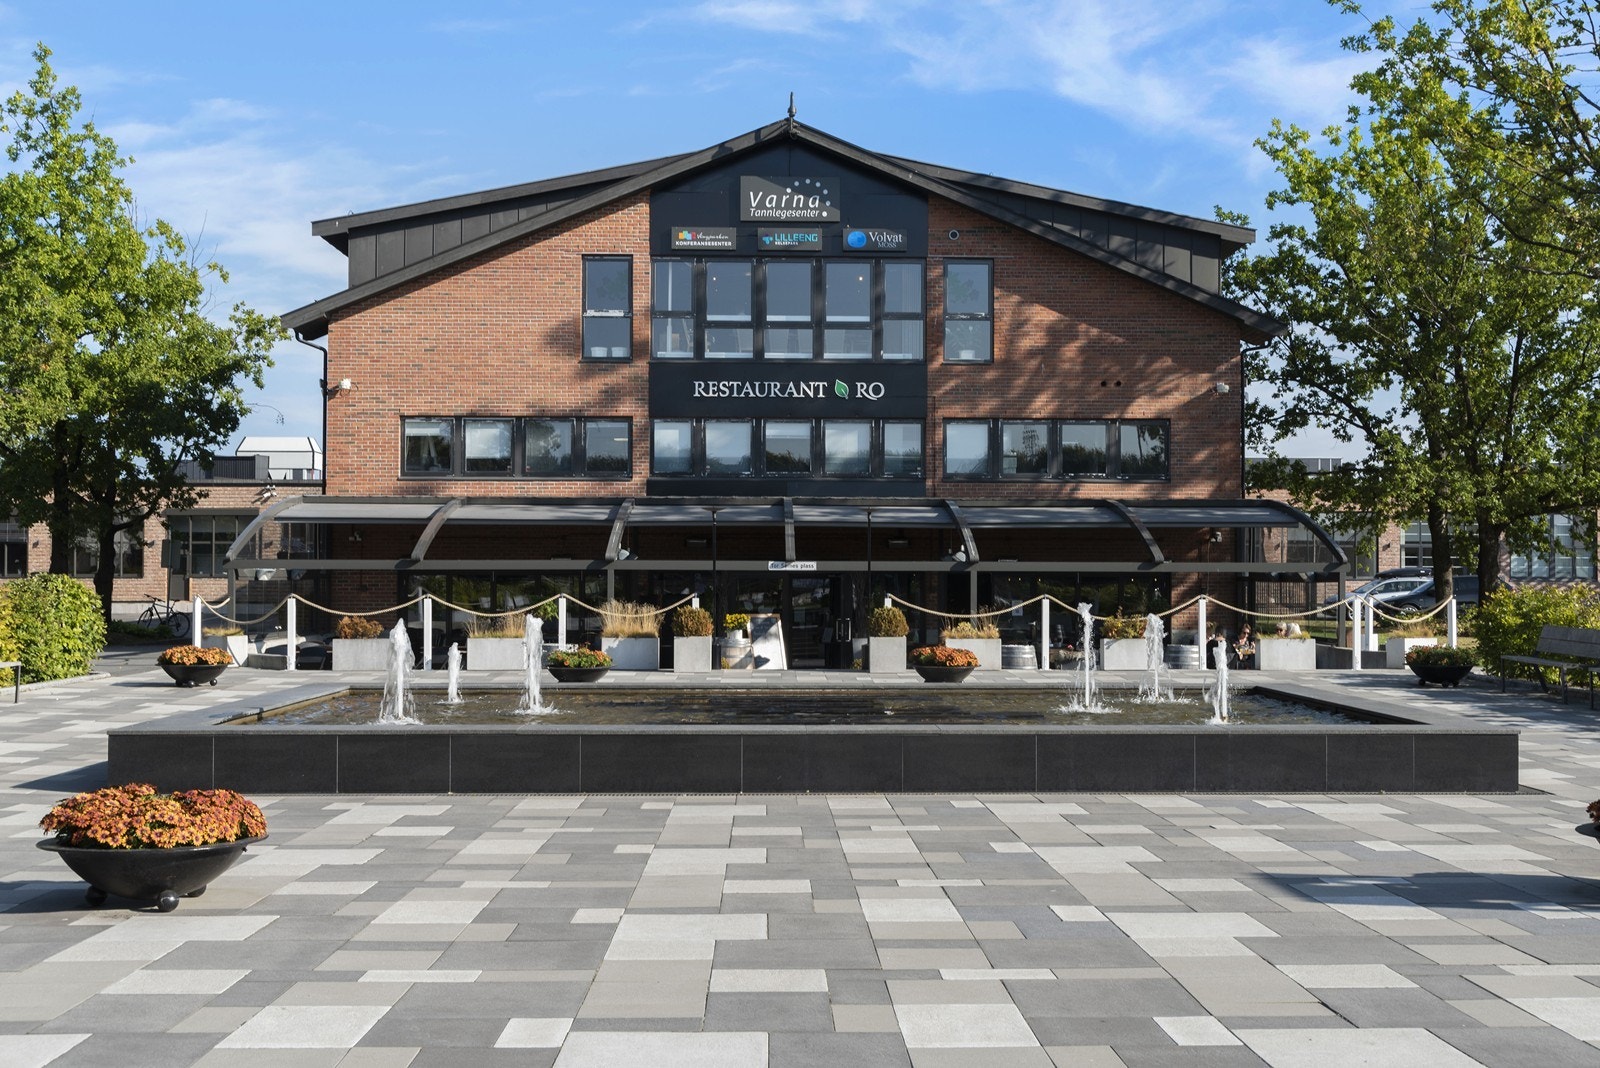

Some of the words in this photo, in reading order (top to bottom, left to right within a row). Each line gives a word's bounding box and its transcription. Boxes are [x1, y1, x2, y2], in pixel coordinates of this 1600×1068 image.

[749, 191, 820, 208] Varna
[749, 208, 819, 220] Tannlegesenter
[774, 233, 818, 242] LILLEENG
[869, 231, 902, 243] Volvat
[693, 380, 828, 398] RESTAURANT
[855, 381, 885, 401] RO
